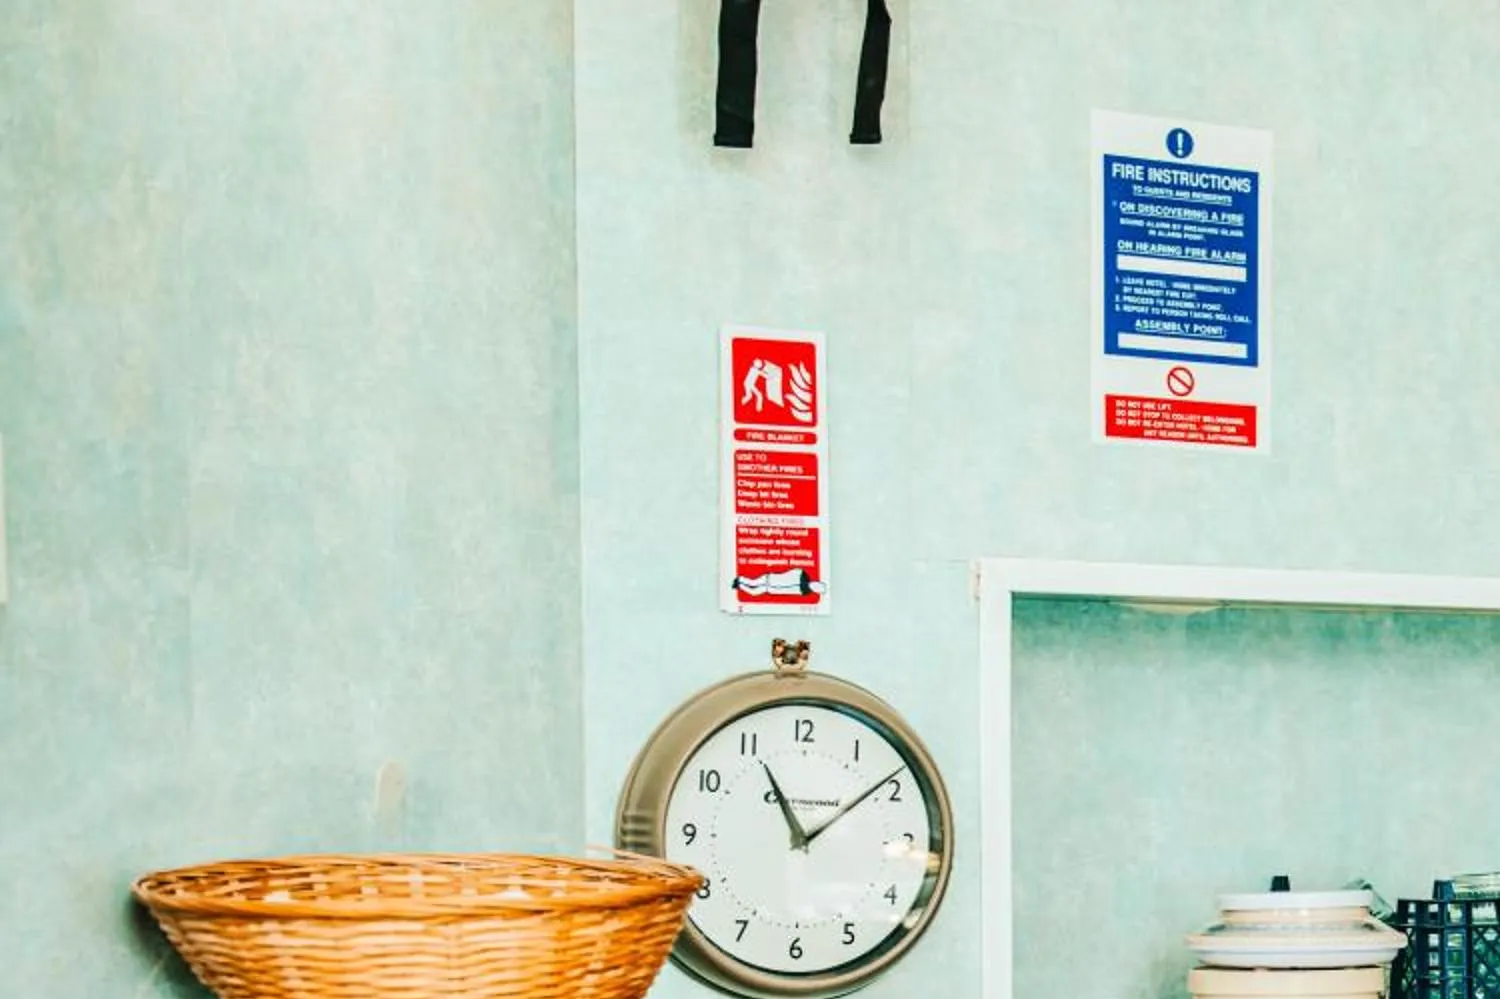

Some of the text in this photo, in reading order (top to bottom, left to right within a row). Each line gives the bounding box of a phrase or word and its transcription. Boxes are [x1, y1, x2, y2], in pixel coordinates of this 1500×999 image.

[1112, 163, 1250, 193] FIRE INSTRUCTIONS
[1120, 201, 1243, 224] ON DISCOVERING A FIRE
[1158, 230, 1181, 238] ALARM
[1118, 240, 1246, 262] ON HEARING FIRE ALARM
[1166, 290, 1179, 298] FIRE
[1167, 299, 1200, 309] ASSEMBLY
[1123, 304, 1148, 314] REPORT
[1152, 307, 1159, 315] TO
[1162, 308, 1188, 318] PERSON
[1136, 319, 1190, 333] ASSEMBLY
[747, 431, 804, 441] FIRE BLANKET
[794, 719, 815, 743] 12
[741, 732, 757, 756] 11
[853, 739, 860, 761] 1
[699, 769, 721, 792] 10
[888, 779, 902, 802] 2
[682, 823, 697, 845] 9
[884, 884, 898, 904] 4
[735, 919, 749, 942] 7
[842, 922, 856, 945] 5
[789, 937, 803, 959] 6
